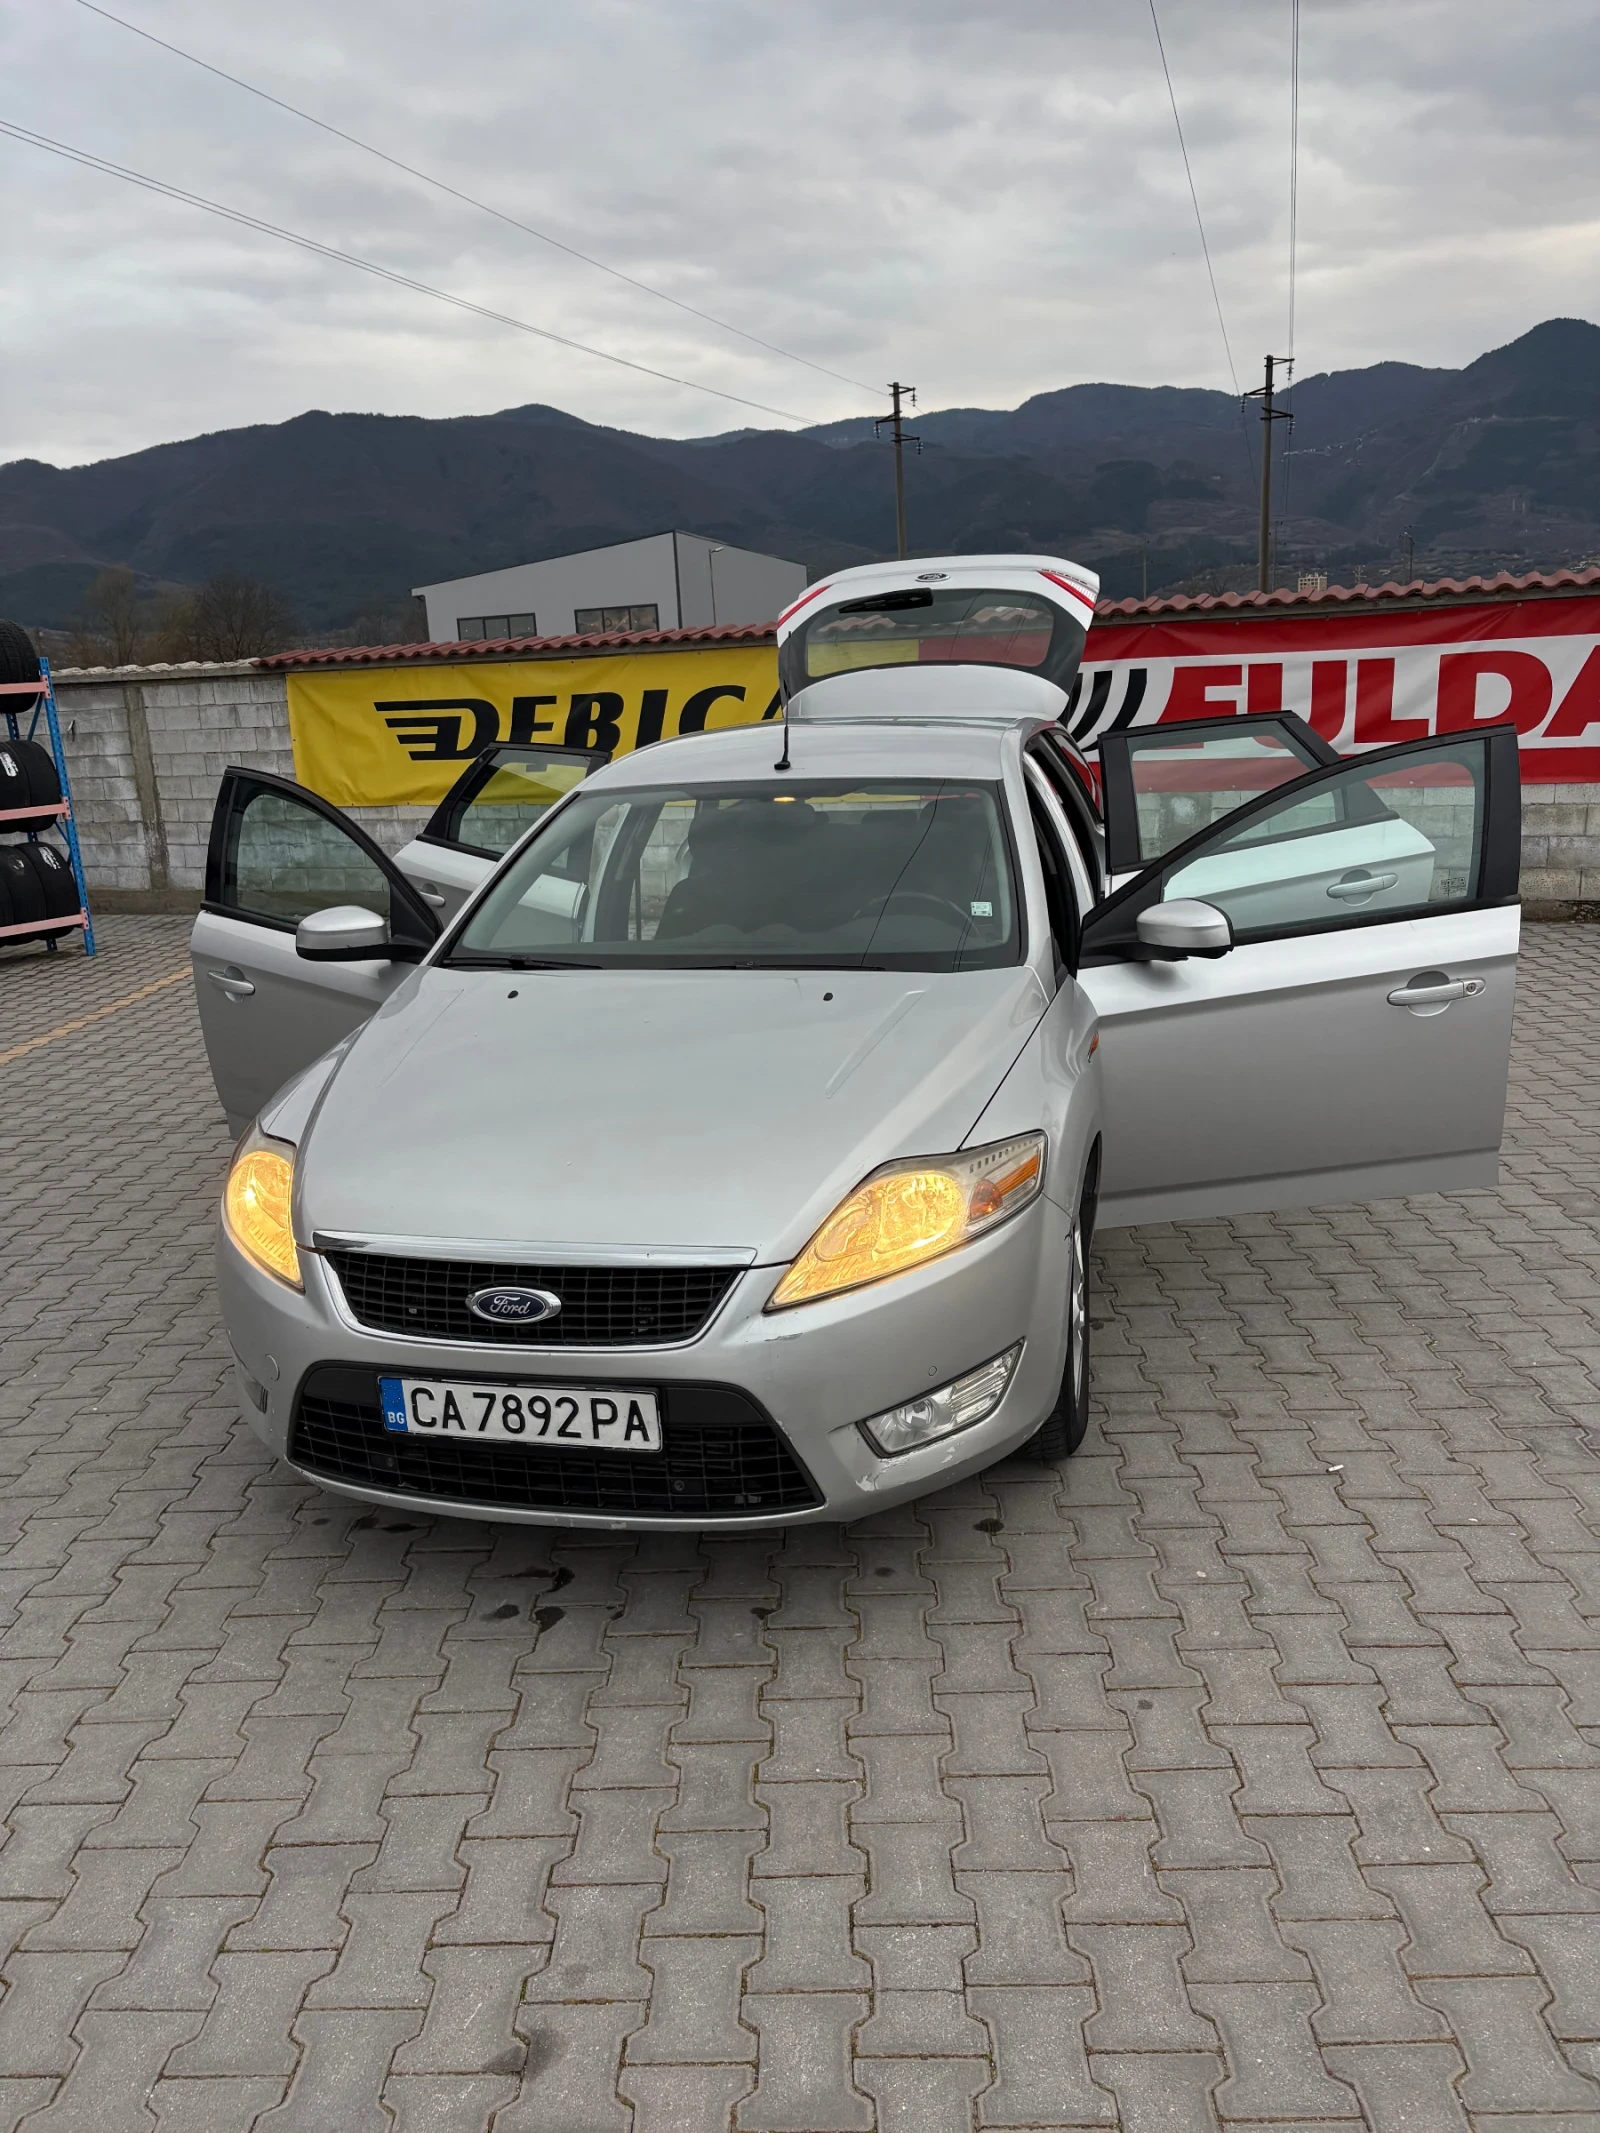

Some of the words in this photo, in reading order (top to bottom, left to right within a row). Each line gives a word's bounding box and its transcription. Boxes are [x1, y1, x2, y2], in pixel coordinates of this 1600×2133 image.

[374, 685, 785, 761] DEBIC
[490, 1295, 531, 1315] Ford
[387, 1411, 405, 1425] BG
[410, 1387, 651, 1442] CA7892PA
